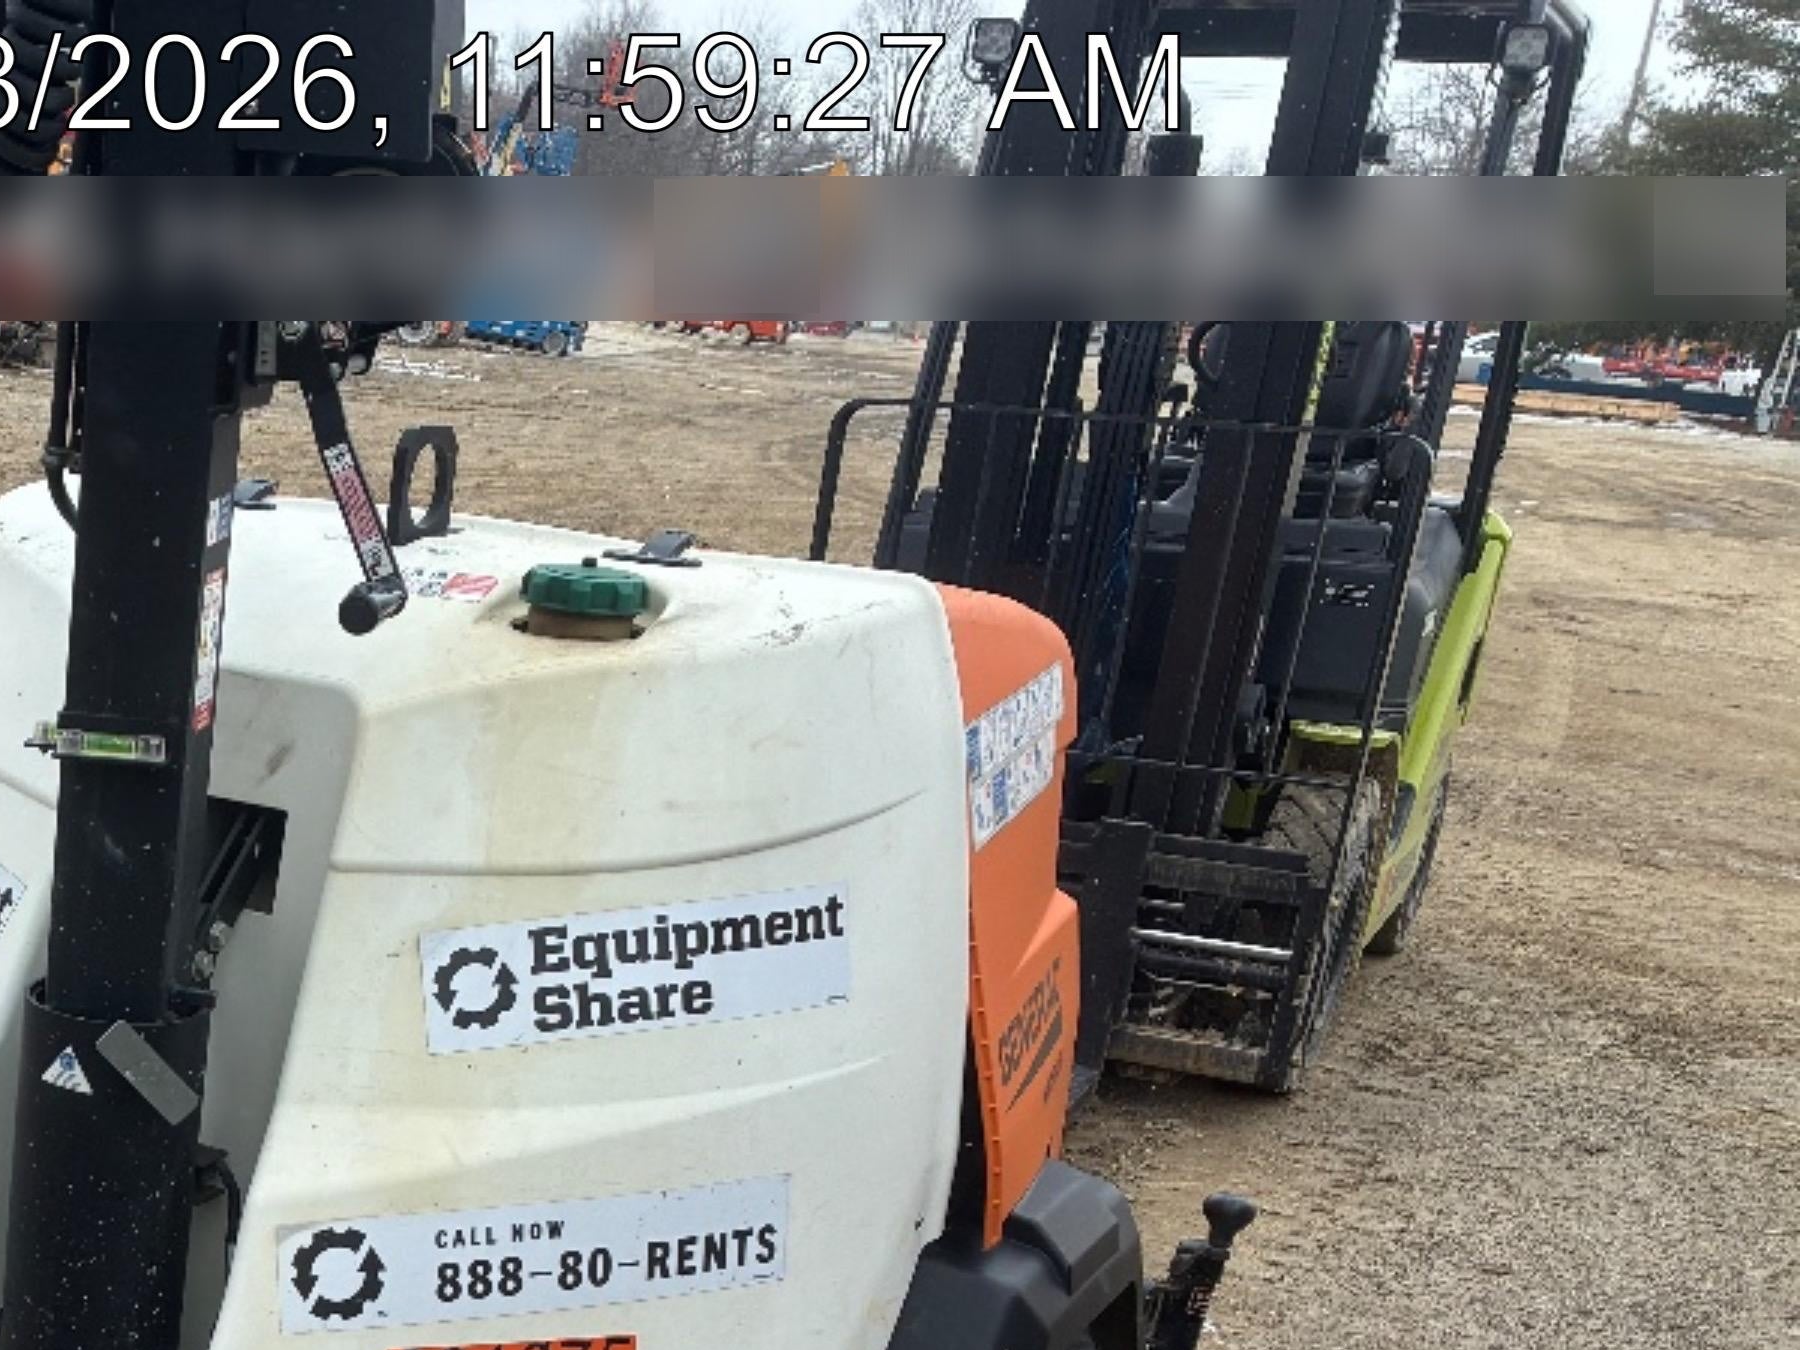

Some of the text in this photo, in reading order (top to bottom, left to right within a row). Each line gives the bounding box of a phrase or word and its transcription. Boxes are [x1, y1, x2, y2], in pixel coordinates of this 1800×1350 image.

[528, 894, 845, 979] Equipment
[532, 979, 714, 1033] Share
[434, 1220, 566, 1249] CALL NOW
[435, 1223, 778, 1303] 888-80-RENTS
